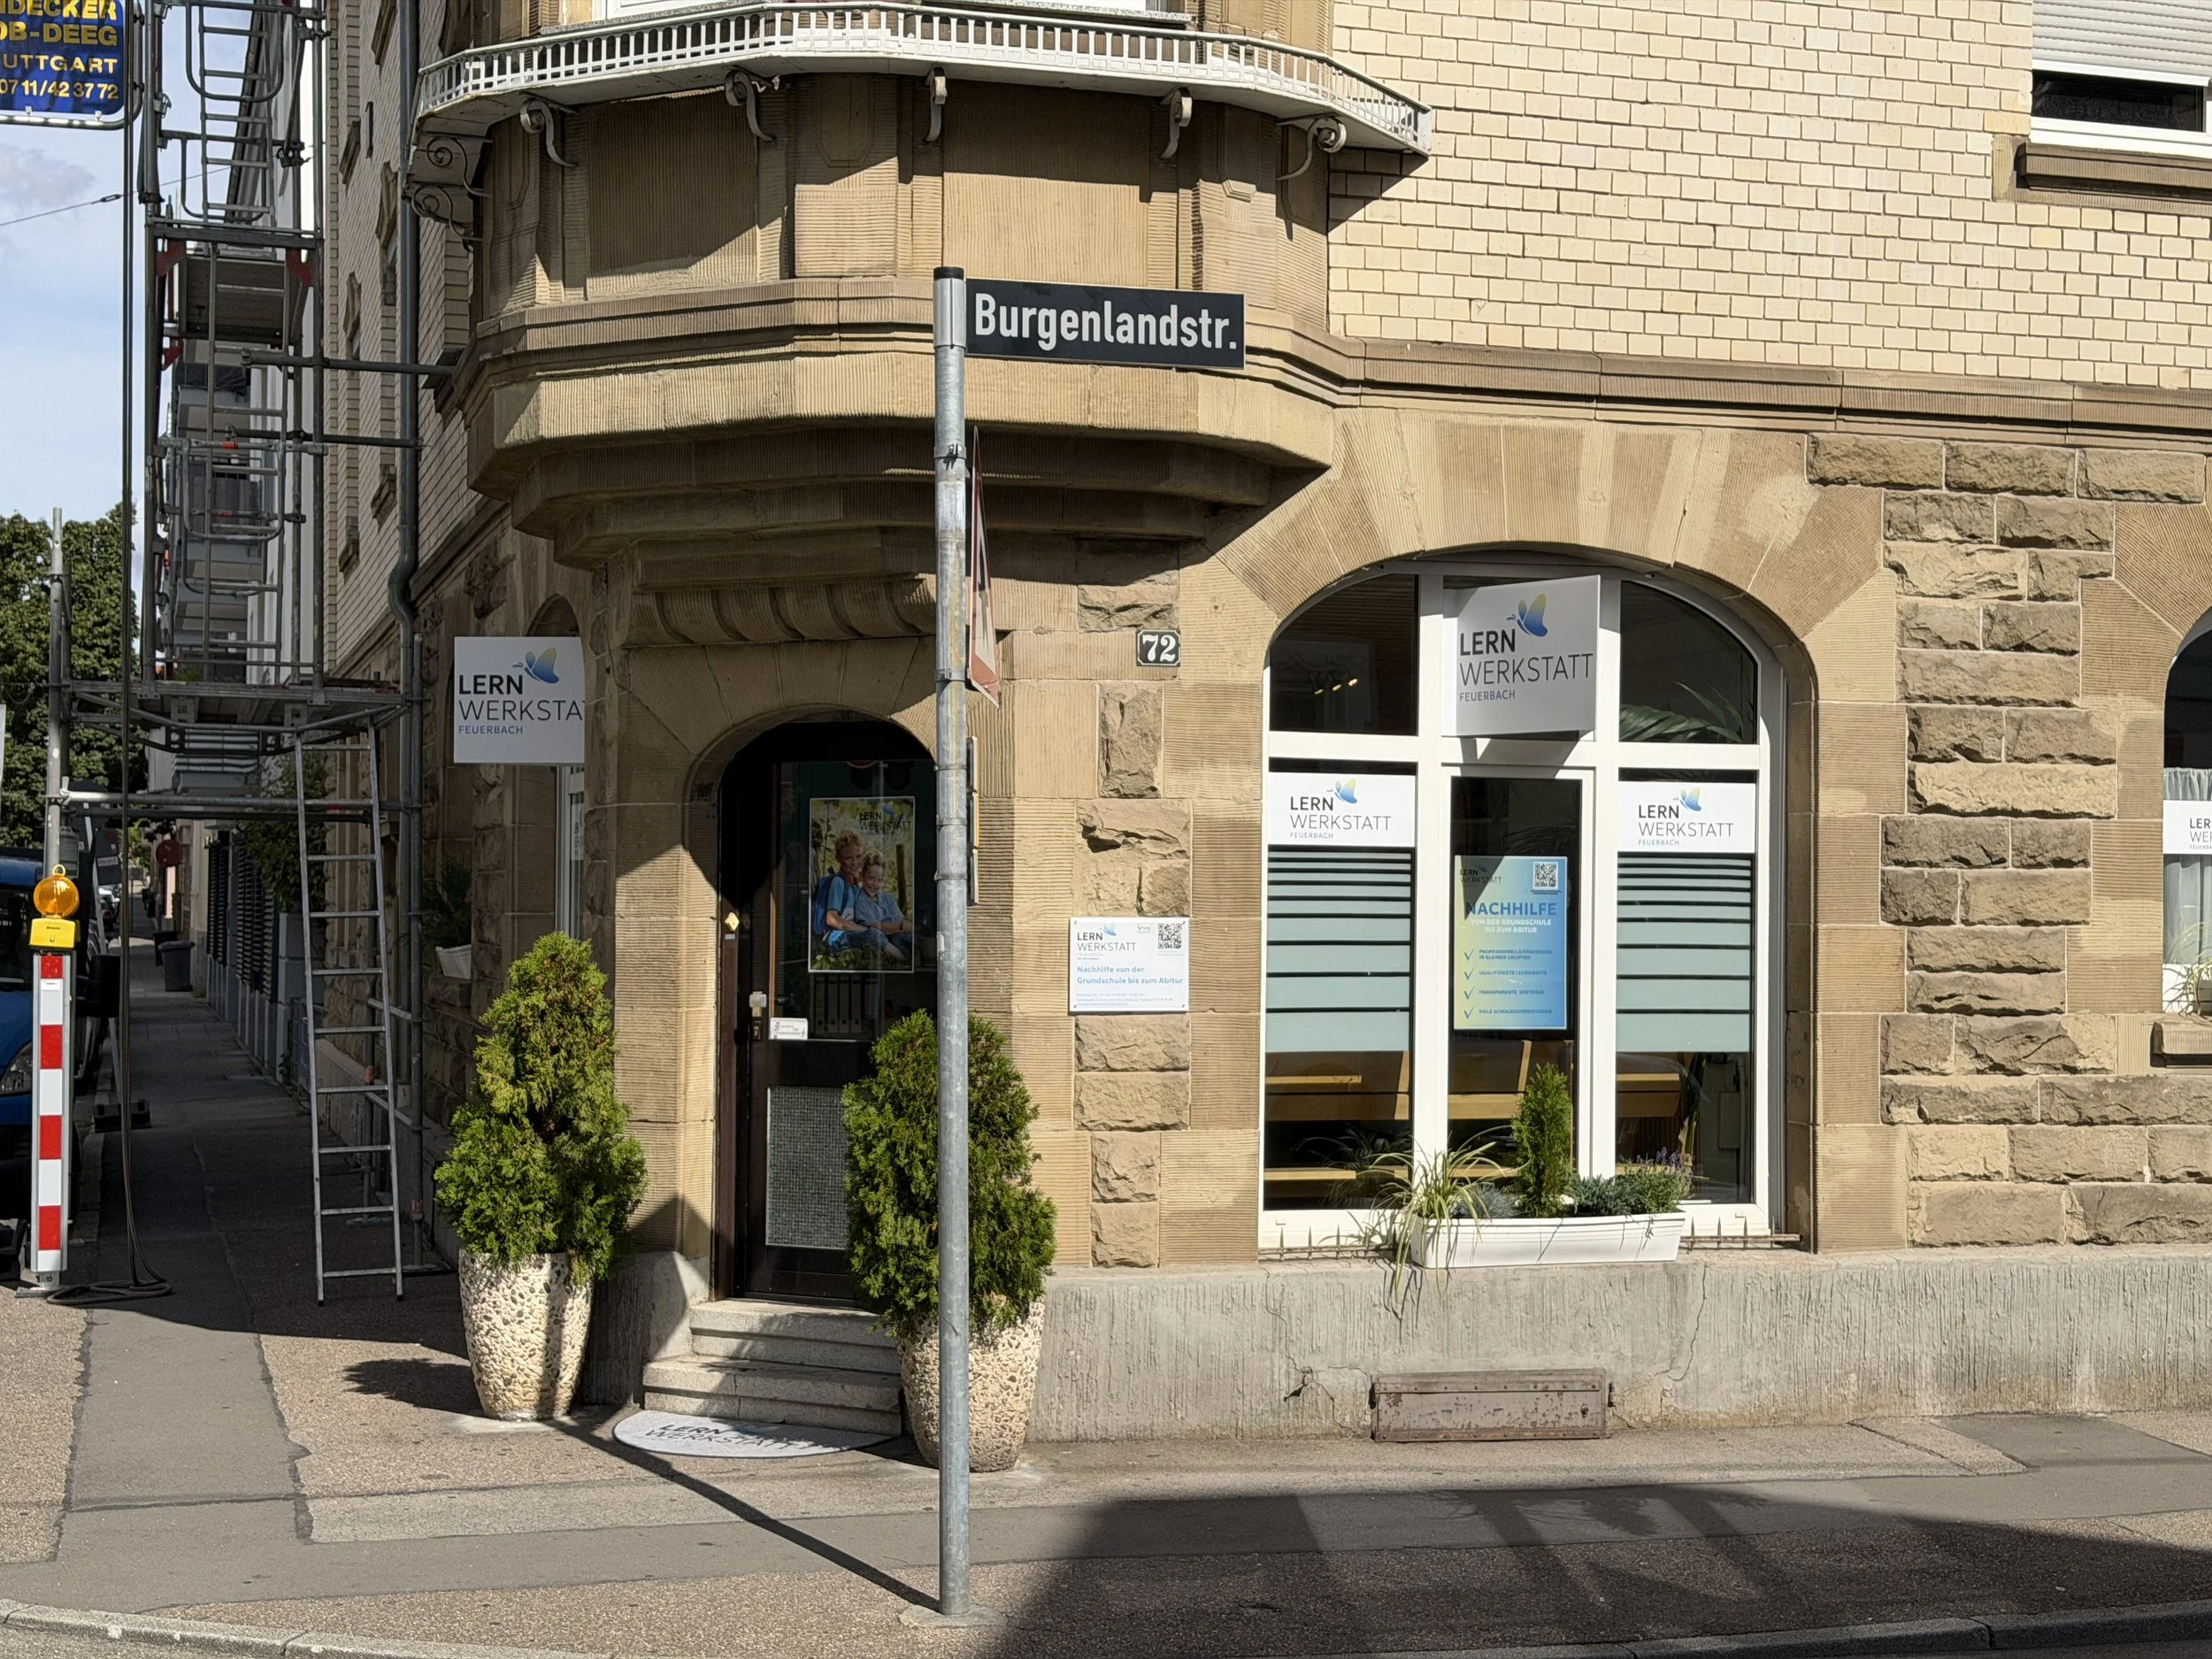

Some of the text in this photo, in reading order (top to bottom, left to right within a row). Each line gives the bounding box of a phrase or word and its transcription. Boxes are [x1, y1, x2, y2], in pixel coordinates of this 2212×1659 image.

[975, 293, 1237, 350] Burgenlandstr.
[1142, 634, 1176, 662] 72
[1460, 628, 1516, 656] LERN
[1460, 652, 1594, 687] WERKSTATT
[458, 674, 523, 695] LERN
[1459, 689, 1516, 702] FEUERBACH
[458, 699, 585, 721] WERKSTA
[458, 725, 523, 735] FEUERBACH
[1290, 796, 1333, 811] LERN
[859, 811, 882, 821] LERN
[1639, 804, 1679, 819] LERN
[1290, 814, 1392, 831] WERKSTATT
[1638, 822, 1734, 838] WERKSTATT
[1466, 902, 1556, 916] NACHHILFE
[1077, 932, 1103, 941] LERN
[1077, 942, 1137, 951] WERKSTATT
[659, 1424, 725, 1435] LERN
